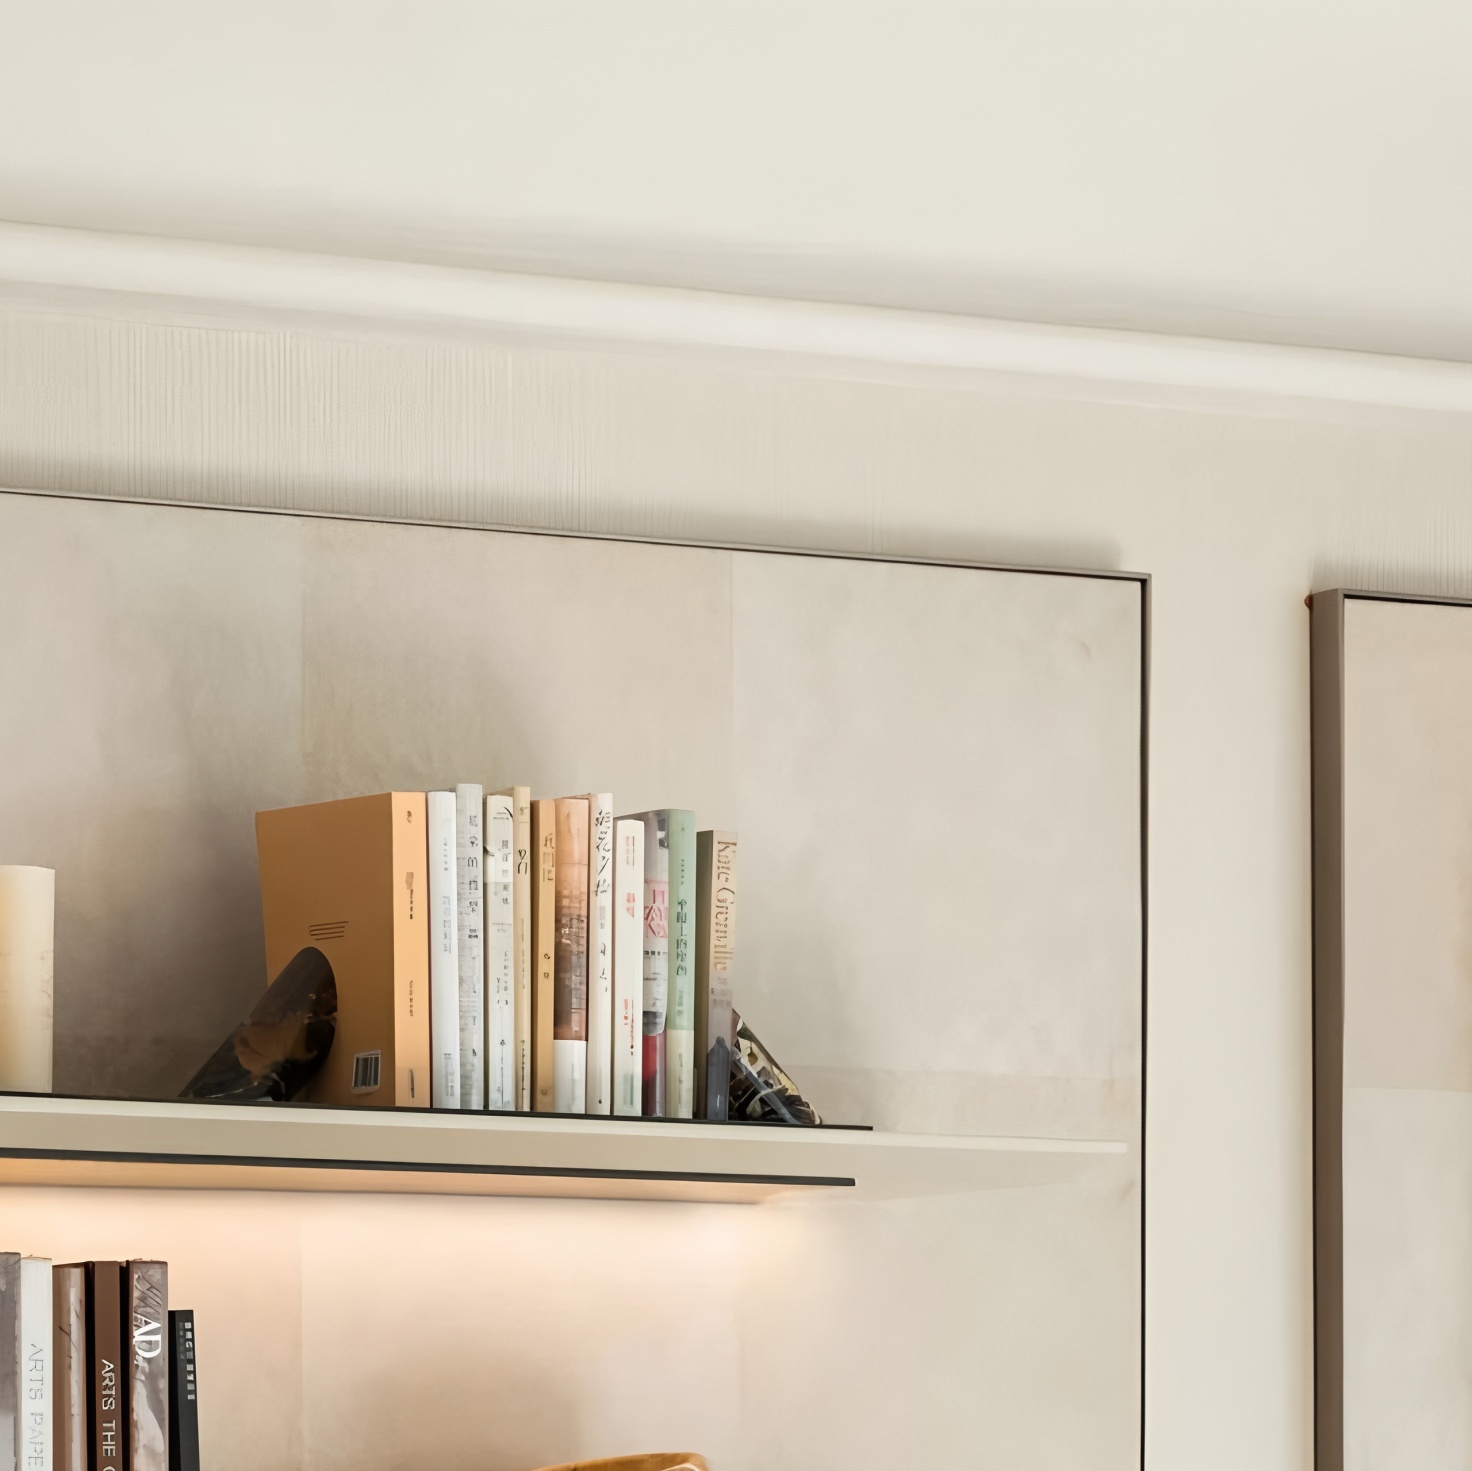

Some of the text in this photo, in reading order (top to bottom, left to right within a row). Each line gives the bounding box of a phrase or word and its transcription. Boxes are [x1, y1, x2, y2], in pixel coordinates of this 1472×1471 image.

[133, 1315, 162, 1359] AD
[101, 1358, 116, 1411] ARTS
[102, 1419, 116, 1457] THE
